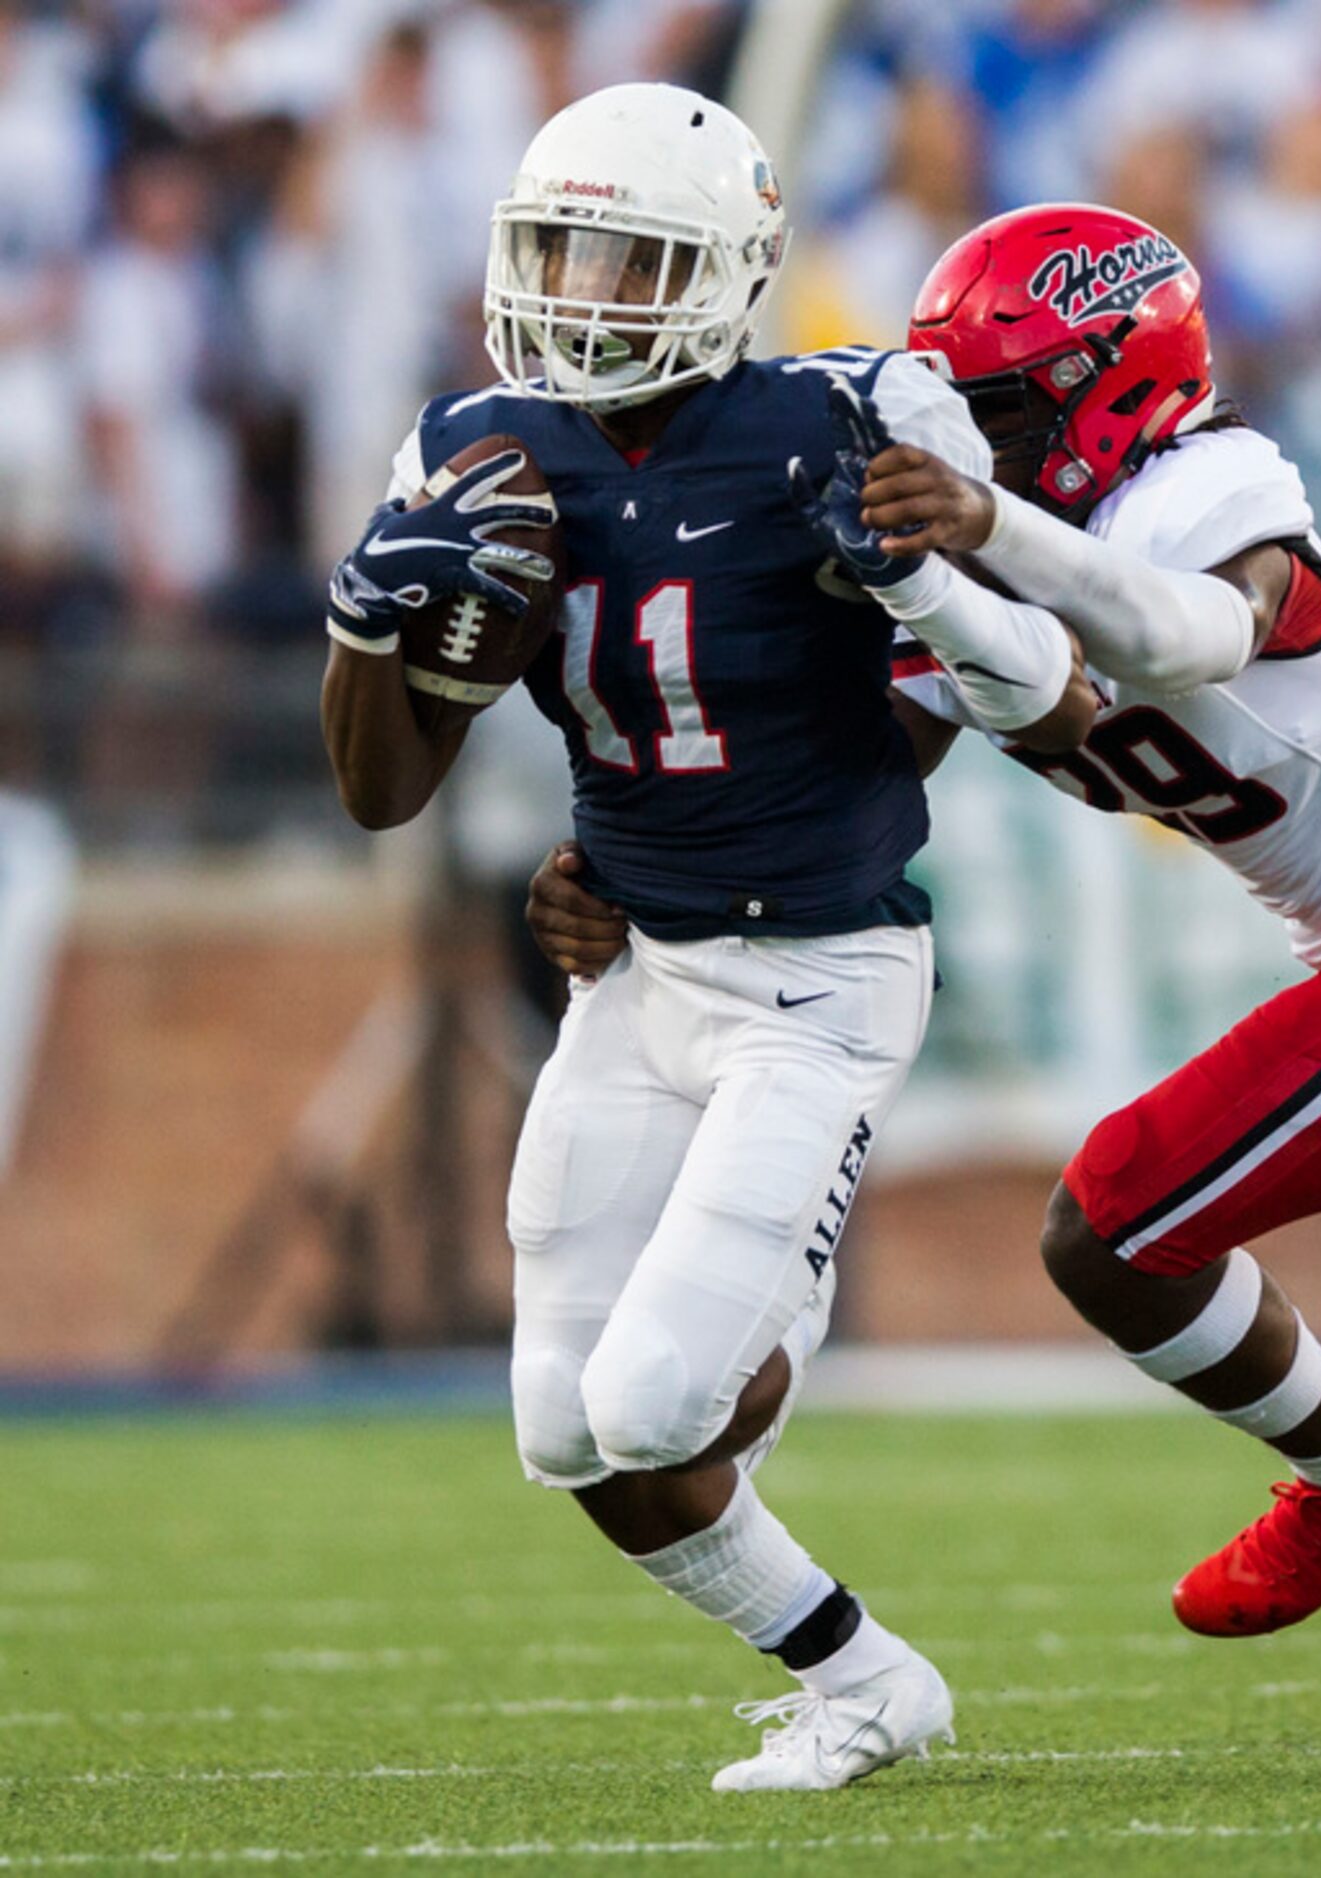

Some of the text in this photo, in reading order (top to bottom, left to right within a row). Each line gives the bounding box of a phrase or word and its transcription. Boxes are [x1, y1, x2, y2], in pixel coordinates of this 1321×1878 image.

[563, 179, 615, 199] Riddell
[1029, 234, 1180, 320] Horns
[556, 577, 730, 775] 11
[804, 1113, 873, 1282] ALLEN
